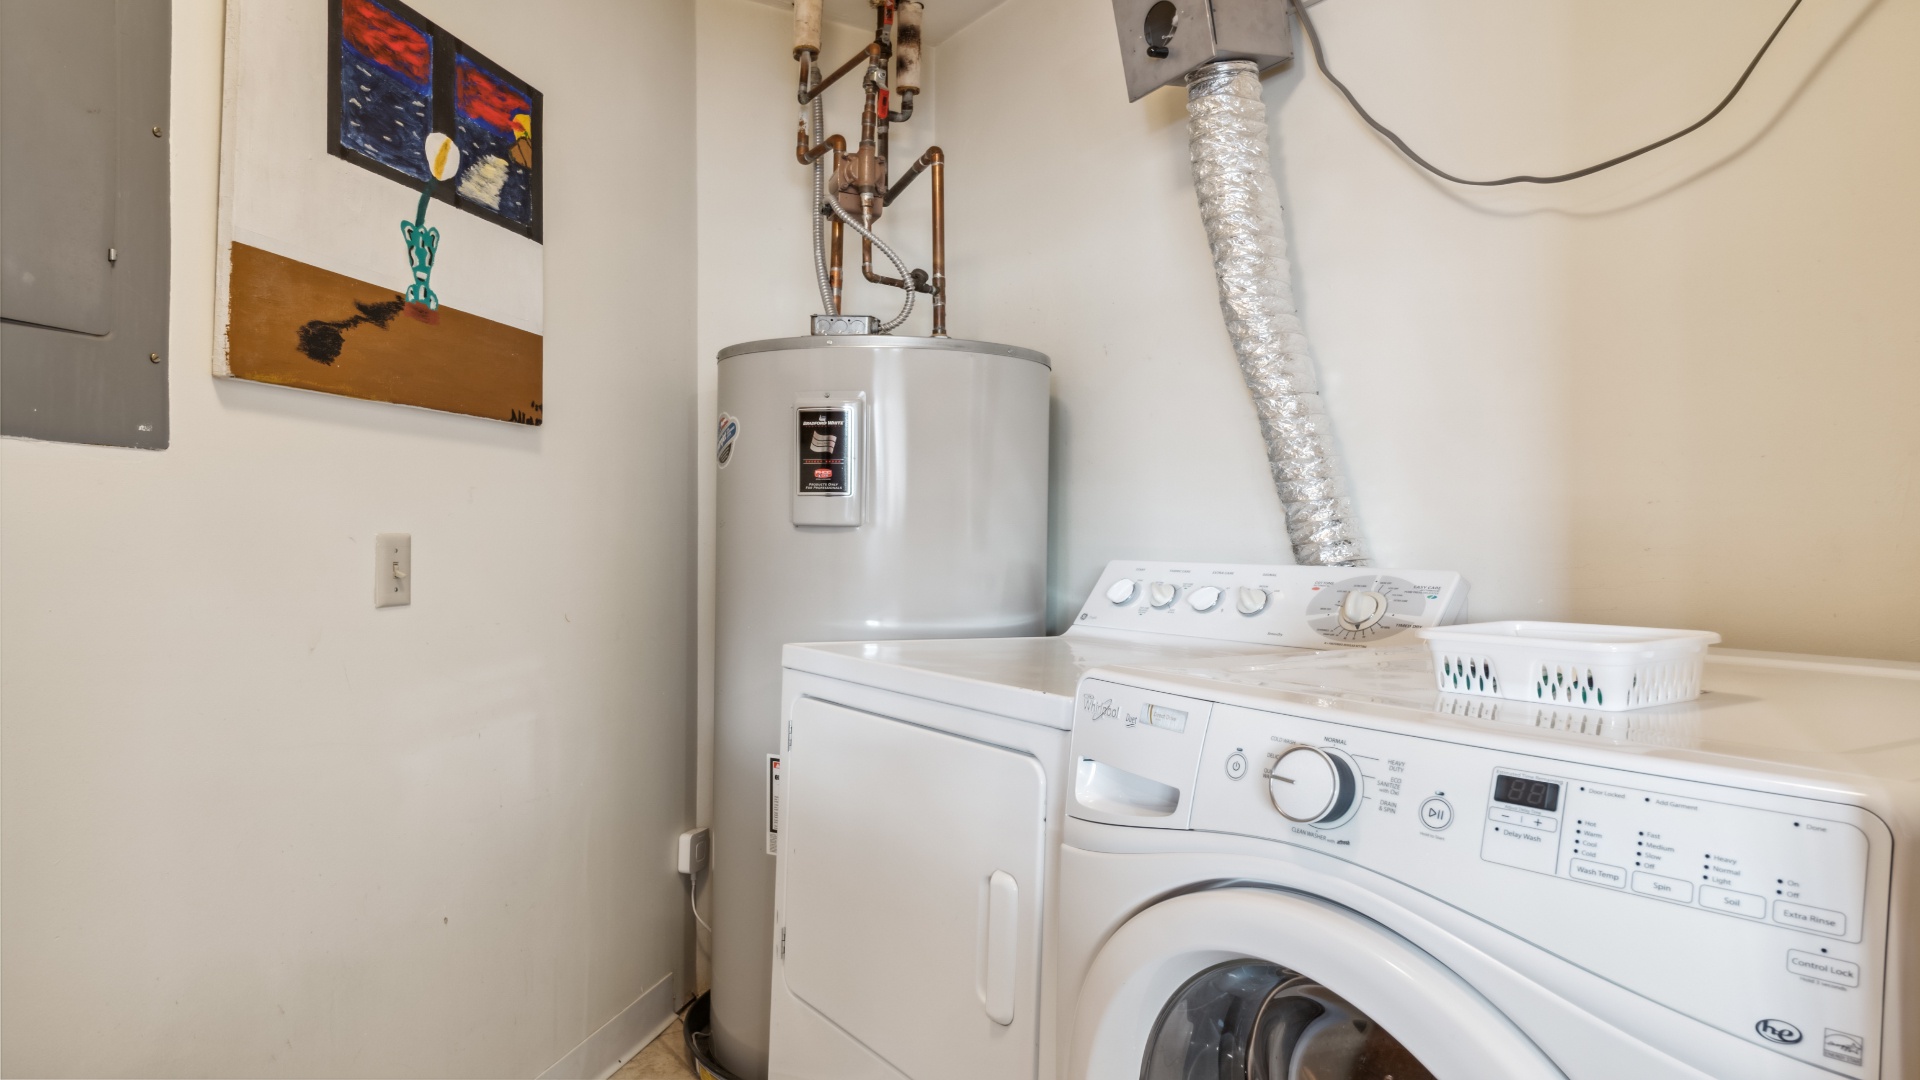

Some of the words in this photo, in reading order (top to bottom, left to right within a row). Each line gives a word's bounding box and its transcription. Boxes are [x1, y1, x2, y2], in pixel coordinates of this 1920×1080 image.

[1083, 698, 1120, 720] Whirlpool
[1270, 735, 1283, 743] COLD
[1323, 736, 1347, 745] NORMAL
[1387, 759, 1406, 767] HEAVY
[1388, 765, 1404, 773] DUTY
[1390, 776, 1402, 784] ECO
[1496, 769, 1521, 778] Estimated
[1535, 775, 1564, 785] Remaining
[1377, 780, 1401, 790] SANITIZE
[1588, 787, 1603, 796] Door
[1604, 790, 1626, 799] Locked
[1380, 800, 1397, 808] DRAIN
[1669, 801, 1698, 811] Garment
[1384, 806, 1396, 814] SPIN
[1584, 820, 1597, 828] Hot
[1806, 824, 1827, 833] Done
[1291, 826, 1306, 835] CLEAN
[1307, 831, 1327, 841] WASHER
[1503, 829, 1522, 840] Delay
[1523, 833, 1541, 843] Wash
[1583, 830, 1602, 839] Warm
[1646, 831, 1661, 840] Fast
[1582, 839, 1598, 848] Cool
[1646, 841, 1675, 853] Medium
[1581, 849, 1596, 858] Cold
[1645, 852, 1661, 861] Slow
[1713, 854, 1737, 865] Heavy
[1643, 862, 1655, 870] Off
[1577, 865, 1597, 876] Wash
[1598, 870, 1620, 881] Temp
[1712, 865, 1741, 877] Normal
[1712, 876, 1732, 886] Light
[1786, 879, 1800, 888] On
[1653, 881, 1672, 892] Spin
[1786, 890, 1800, 899] Off
[1723, 896, 1741, 907] Soil
[1783, 909, 1808, 921] Extra
[1809, 914, 1837, 928] Rinse
[1791, 957, 1828, 972] Control
[1830, 966, 1855, 979] Lock
